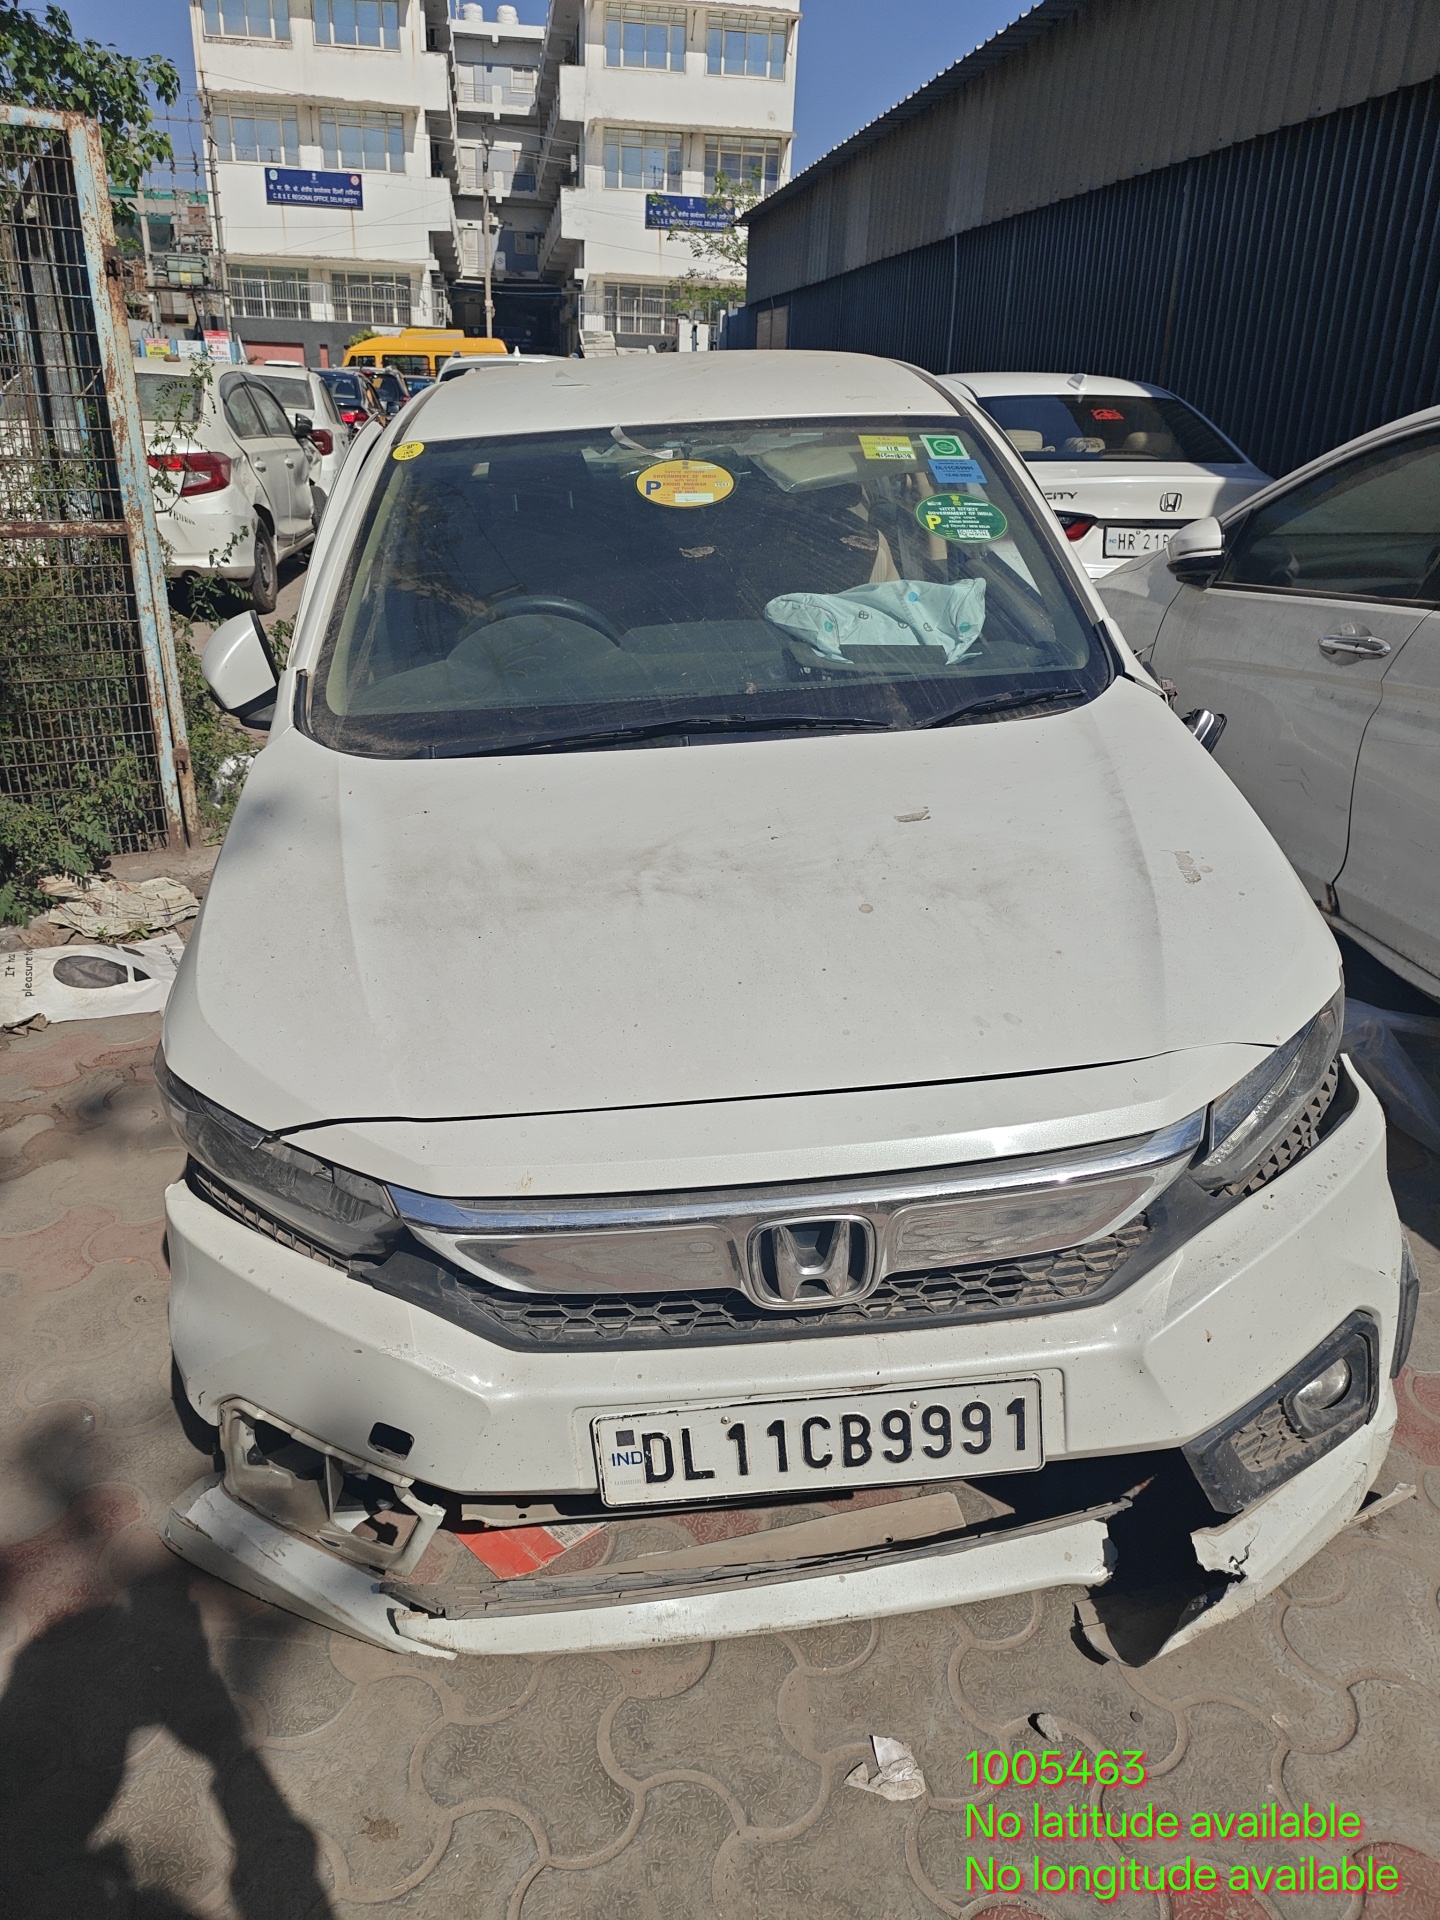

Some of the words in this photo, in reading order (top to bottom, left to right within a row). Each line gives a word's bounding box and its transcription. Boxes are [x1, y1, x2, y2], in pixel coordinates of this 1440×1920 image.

[292, 194, 313, 202] REGIONAL
[646, 480, 662, 495] P
[925, 514, 942, 530] P
[5, 966, 16, 977] It
[21, 958, 35, 997] pleasure
[641, 1396, 1026, 1484] DL11CB9991
[611, 1450, 643, 1467] IND
